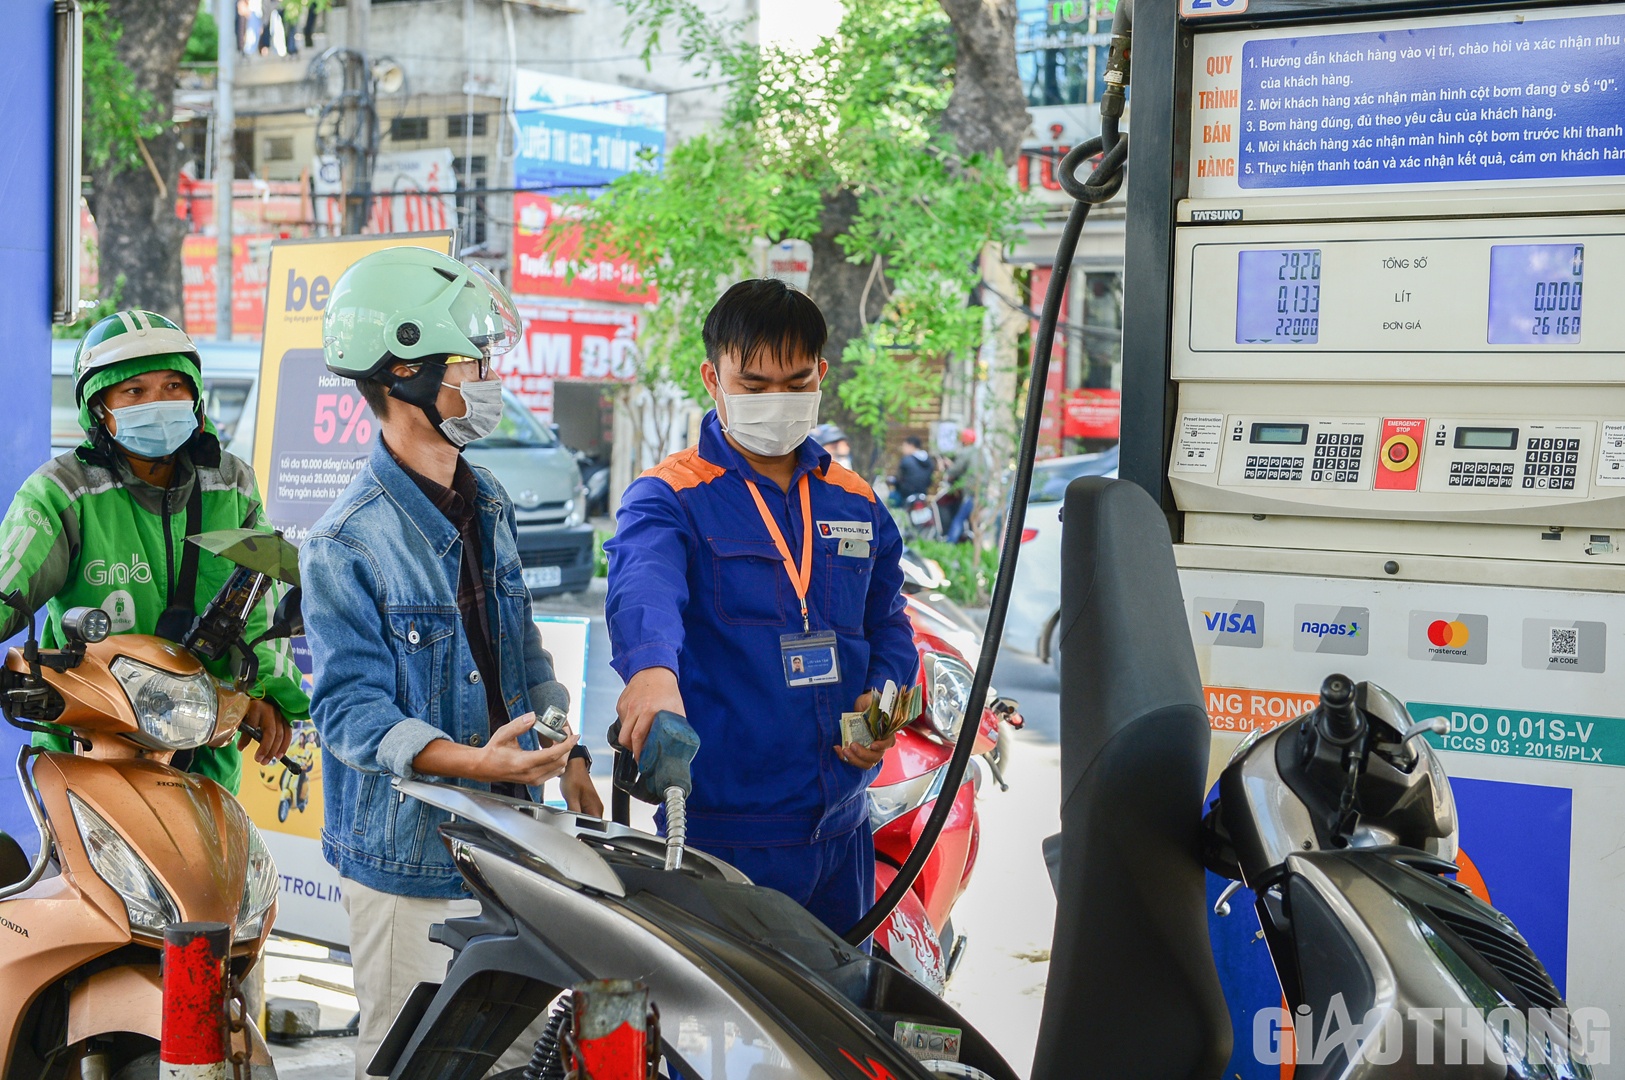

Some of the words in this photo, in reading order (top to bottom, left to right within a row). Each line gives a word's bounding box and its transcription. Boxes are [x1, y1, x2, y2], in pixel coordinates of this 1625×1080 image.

[1248, 57, 1258, 69] 1.
[1261, 55, 1301, 69] Hướng
[1304, 51, 1326, 65] dẫn
[1328, 50, 1364, 63] khách
[1367, 49, 1396, 62] hàng
[1400, 46, 1422, 59] vào
[1425, 45, 1436, 60] vị
[1438, 44, 1455, 58] trí,
[1458, 42, 1489, 55] chào
[1492, 40, 1512, 53] hỏi
[1515, 39, 1530, 51] và
[1533, 37, 1556, 50] xác
[1560, 35, 1591, 50] nhận
[1595, 33, 1620, 46] nhu
[1206, 55, 1233, 76] QUY
[1260, 77, 1281, 89] của
[1284, 74, 1318, 88] khách
[1321, 73, 1353, 87] hàng.
[1199, 87, 1238, 109] TRÌNH
[1246, 99, 1257, 111] 2.
[1260, 97, 1282, 110] Mời
[1284, 96, 1318, 109] khách
[1322, 94, 1351, 109] hàng
[1353, 93, 1374, 105] xác
[1378, 91, 1406, 106] nhận
[1410, 89, 1436, 104] màn
[1439, 87, 1467, 101] hình
[1470, 86, 1490, 101] cột
[1493, 85, 1522, 98] bơm
[1525, 83, 1557, 97] đang
[1560, 81, 1571, 94] ở
[1573, 77, 1590, 93] số
[1246, 120, 1256, 132] 3.
[1258, 119, 1287, 132] Bơm
[1289, 118, 1318, 132] hàng
[1320, 116, 1354, 130] đúng,
[1356, 114, 1372, 127] đủ
[1374, 113, 1402, 126] theo
[1404, 111, 1427, 127] yêu
[1429, 108, 1452, 123] cầu
[1454, 108, 1477, 122] của
[1480, 106, 1518, 121] khách
[1522, 103, 1557, 120] hàng.
[1203, 121, 1231, 143] BÁN
[1244, 141, 1255, 153] 4.
[1258, 140, 1280, 153] Mời
[1282, 138, 1317, 152] khách
[1320, 137, 1349, 152] hàng
[1352, 136, 1373, 149] xác
[1376, 134, 1406, 150] nhận
[1408, 133, 1435, 146] màn
[1438, 131, 1465, 145] hình
[1468, 130, 1488, 146] cột
[1491, 130, 1520, 142] bơm
[1523, 127, 1560, 141] trước
[1562, 125, 1583, 139] khi
[1585, 124, 1623, 138] thanh
[1197, 156, 1235, 177] HÀNG
[1244, 163, 1254, 174] 5.
[1257, 162, 1287, 176] Thực
[1290, 160, 1314, 175] hiện
[1317, 158, 1350, 171] thanh
[1353, 157, 1380, 170] toán
[1382, 156, 1396, 169] và
[1399, 155, 1421, 168] xác
[1424, 154, 1454, 169] nhận
[1457, 150, 1477, 166] kết
[1479, 151, 1506, 168] quả,
[1509, 150, 1536, 164] cám
[1539, 152, 1557, 162] ơn
[1560, 147, 1600, 162] khách
[1193, 210, 1240, 220] TATSUNO
[1279, 252, 1320, 280] 2926
[1382, 256, 1410, 269] TỔNG
[1413, 256, 1428, 269] SỐ
[1572, 246, 1584, 276] 0
[285, 269, 330, 312] be
[1278, 285, 1320, 314] 0,133
[1395, 290, 1411, 302] LÍT
[1534, 282, 1582, 313] 0,000
[1276, 318, 1318, 335] 22000
[1383, 321, 1403, 330] ĐƠN
[1405, 320, 1421, 330] GIÁ
[1532, 317, 1580, 335] 26160
[318, 375, 340, 387] Hoàn
[313, 394, 371, 444] 5%
[1530, 440, 1537, 448] 7
[1544, 440, 1550, 449] 8
[1557, 440, 1563, 449] 9
[301, 459, 322, 469] 10.000
[1528, 452, 1535, 461] 4
[1542, 453, 1548, 461] 5
[1555, 453, 1561, 462] 6
[280, 472, 299, 485] không
[314, 473, 350, 484] 25.000.000
[1528, 465, 1532, 474] 1
[1540, 466, 1547, 474] 2
[1553, 466, 1560, 475] 3
[279, 485, 294, 499] Tổng
[295, 487, 311, 499] ngân
[312, 487, 328, 498] sách
[329, 488, 336, 498] là
[1525, 478, 1532, 487] 0
[1538, 479, 1546, 487] C
[84, 554, 152, 586] Grab
[1201, 611, 1256, 634] VISA
[1301, 621, 1346, 637] napas
[1206, 692, 1243, 714] NG
[1451, 711, 1488, 734] DO
[1496, 715, 1594, 743] 0,01S-V
[1440, 735, 1486, 751] TCCS
[1490, 738, 1510, 753] 03
[1524, 742, 1603, 762] 2015/PLX
[279, 874, 341, 902] TROLI
